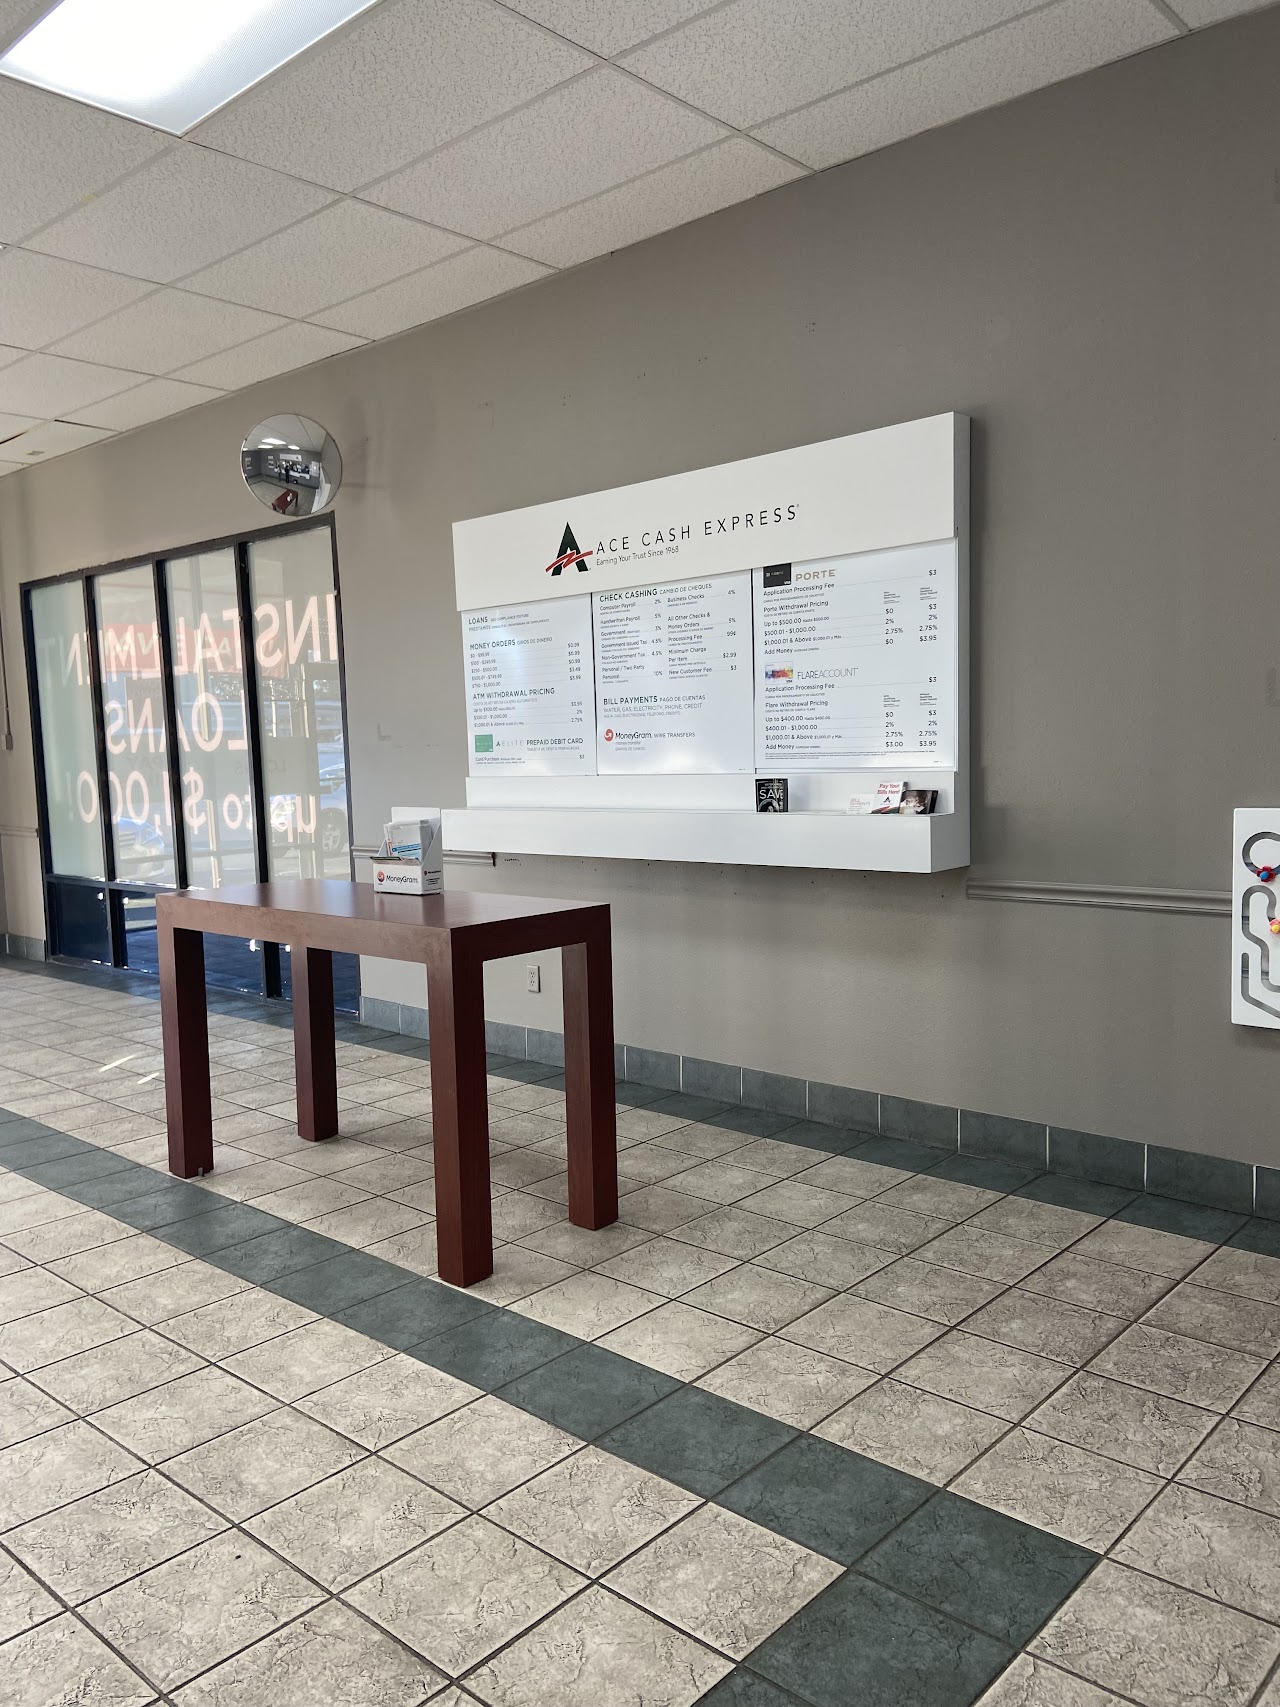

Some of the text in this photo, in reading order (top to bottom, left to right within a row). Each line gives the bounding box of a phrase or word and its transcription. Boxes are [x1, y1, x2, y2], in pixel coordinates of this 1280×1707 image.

[596, 504, 796, 555] ACE CASH EXPRESS
[596, 556, 618, 566] Earning
[632, 552, 646, 560] Trust
[648, 550, 663, 558] Since
[665, 546, 679, 554] 1968
[795, 569, 836, 581] PORTE
[600, 593, 623, 602] CHECK
[625, 588, 657, 599] CASHING
[763, 588, 793, 596] Application
[794, 584, 823, 592] Processing
[764, 605, 777, 613] Porte
[779, 602, 809, 611] Withdrawal
[468, 616, 488, 625] LOANS
[789, 626, 816, 634] $1,000.00
[470, 642, 490, 650] MONEY
[492, 639, 515, 648] ORDERS
[486, 690, 527, 699] WITHDRAWAL
[529, 687, 555, 695] PRICING
[620, 695, 658, 704] PAYMENTS
